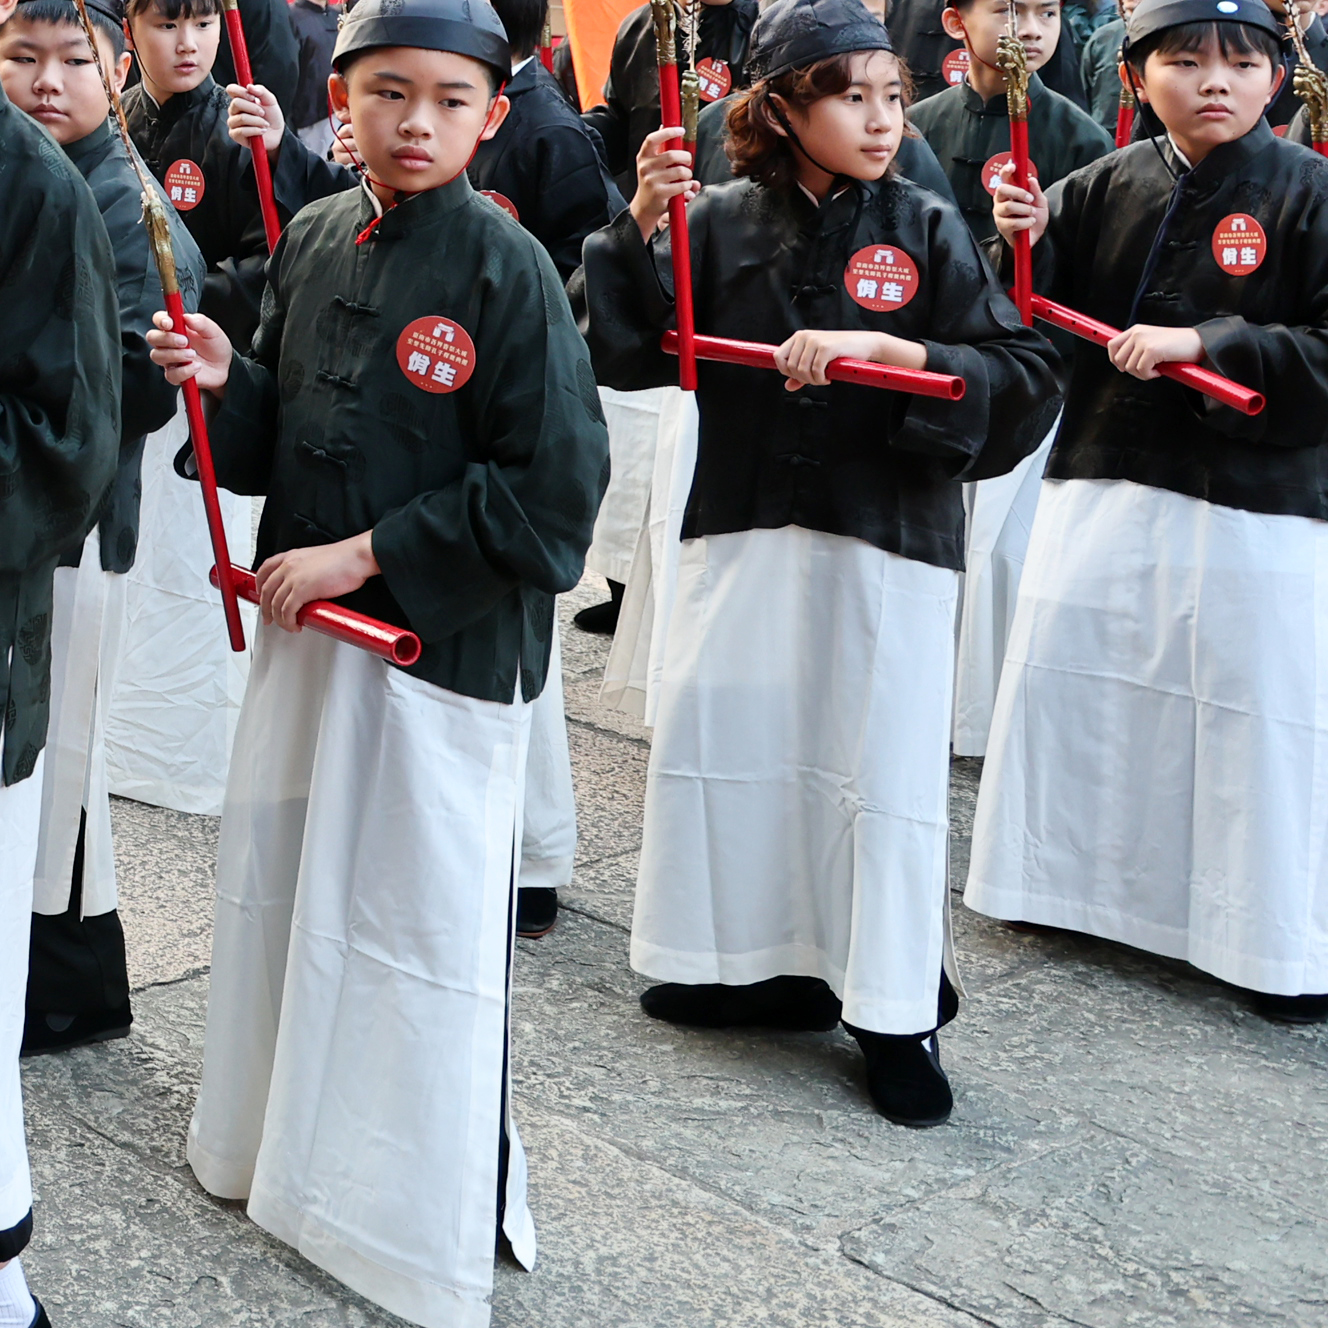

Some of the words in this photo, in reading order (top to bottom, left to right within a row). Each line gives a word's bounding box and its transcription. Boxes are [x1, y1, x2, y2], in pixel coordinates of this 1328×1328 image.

[1222, 247, 1257, 265] 佾生
[856, 278, 904, 303] 佾生
[407, 350, 457, 387] 佾生
